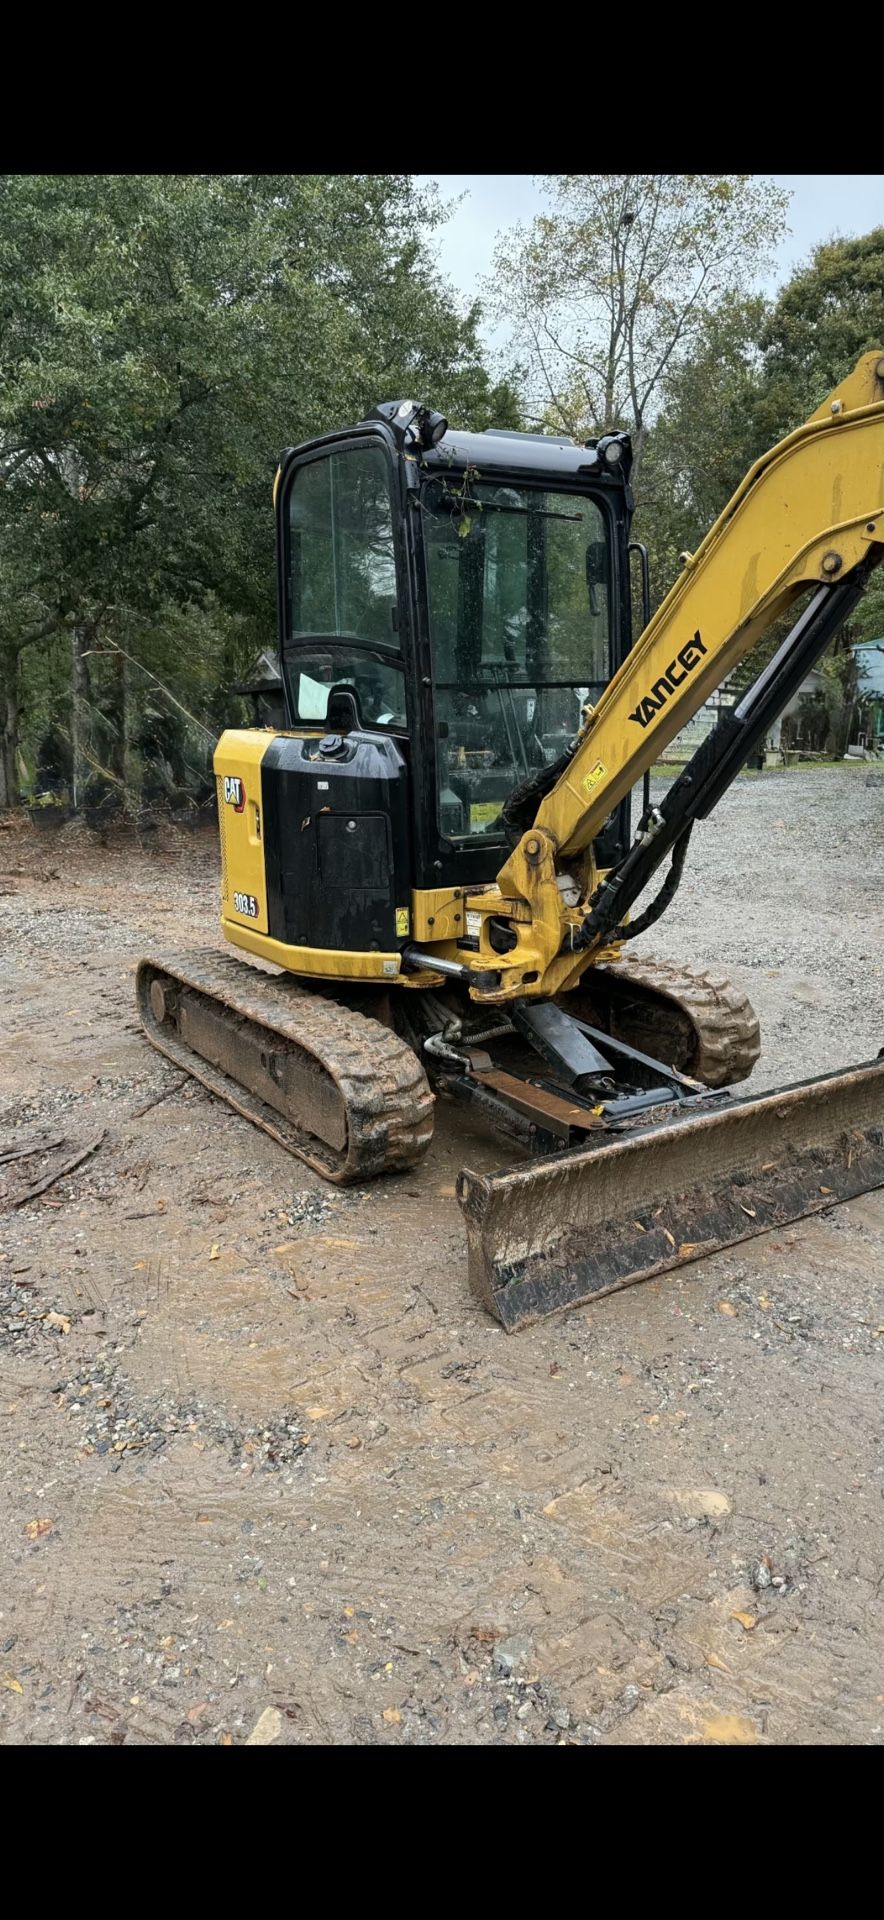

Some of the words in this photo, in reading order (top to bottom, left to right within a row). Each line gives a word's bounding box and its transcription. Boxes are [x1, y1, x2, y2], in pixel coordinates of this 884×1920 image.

[628, 629, 708, 728] YANCEY
[224, 777, 241, 805] CAT
[234, 892, 256, 917] 303.5
